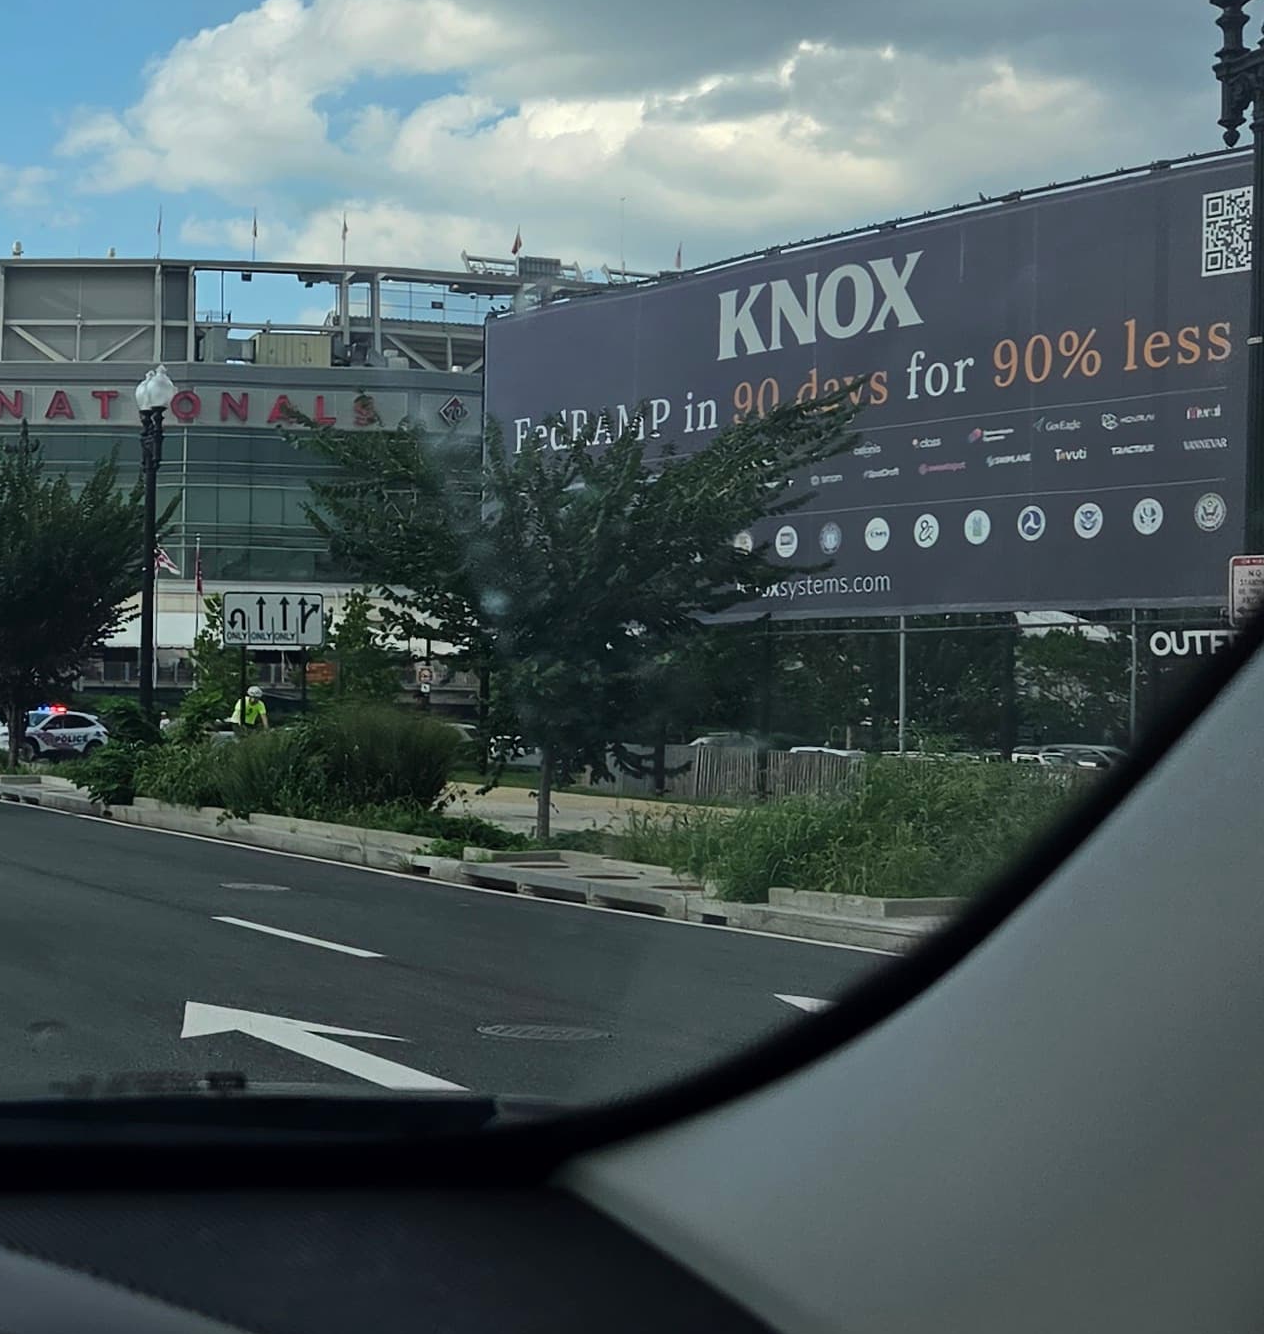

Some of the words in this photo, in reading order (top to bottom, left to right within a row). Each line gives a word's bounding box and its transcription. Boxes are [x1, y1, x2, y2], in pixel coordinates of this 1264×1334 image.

[717, 250, 924, 361] KNOX
[683, 392, 718, 433] in
[733, 378, 780, 424] 90
[906, 350, 975, 400] for
[992, 327, 1102, 388] 90%
[1123, 317, 1232, 372] less
[227, 632, 248, 641] ONLY
[251, 632, 272, 641] ONLY
[275, 632, 295, 641] ONLY
[55, 734, 88, 743] POLICE
